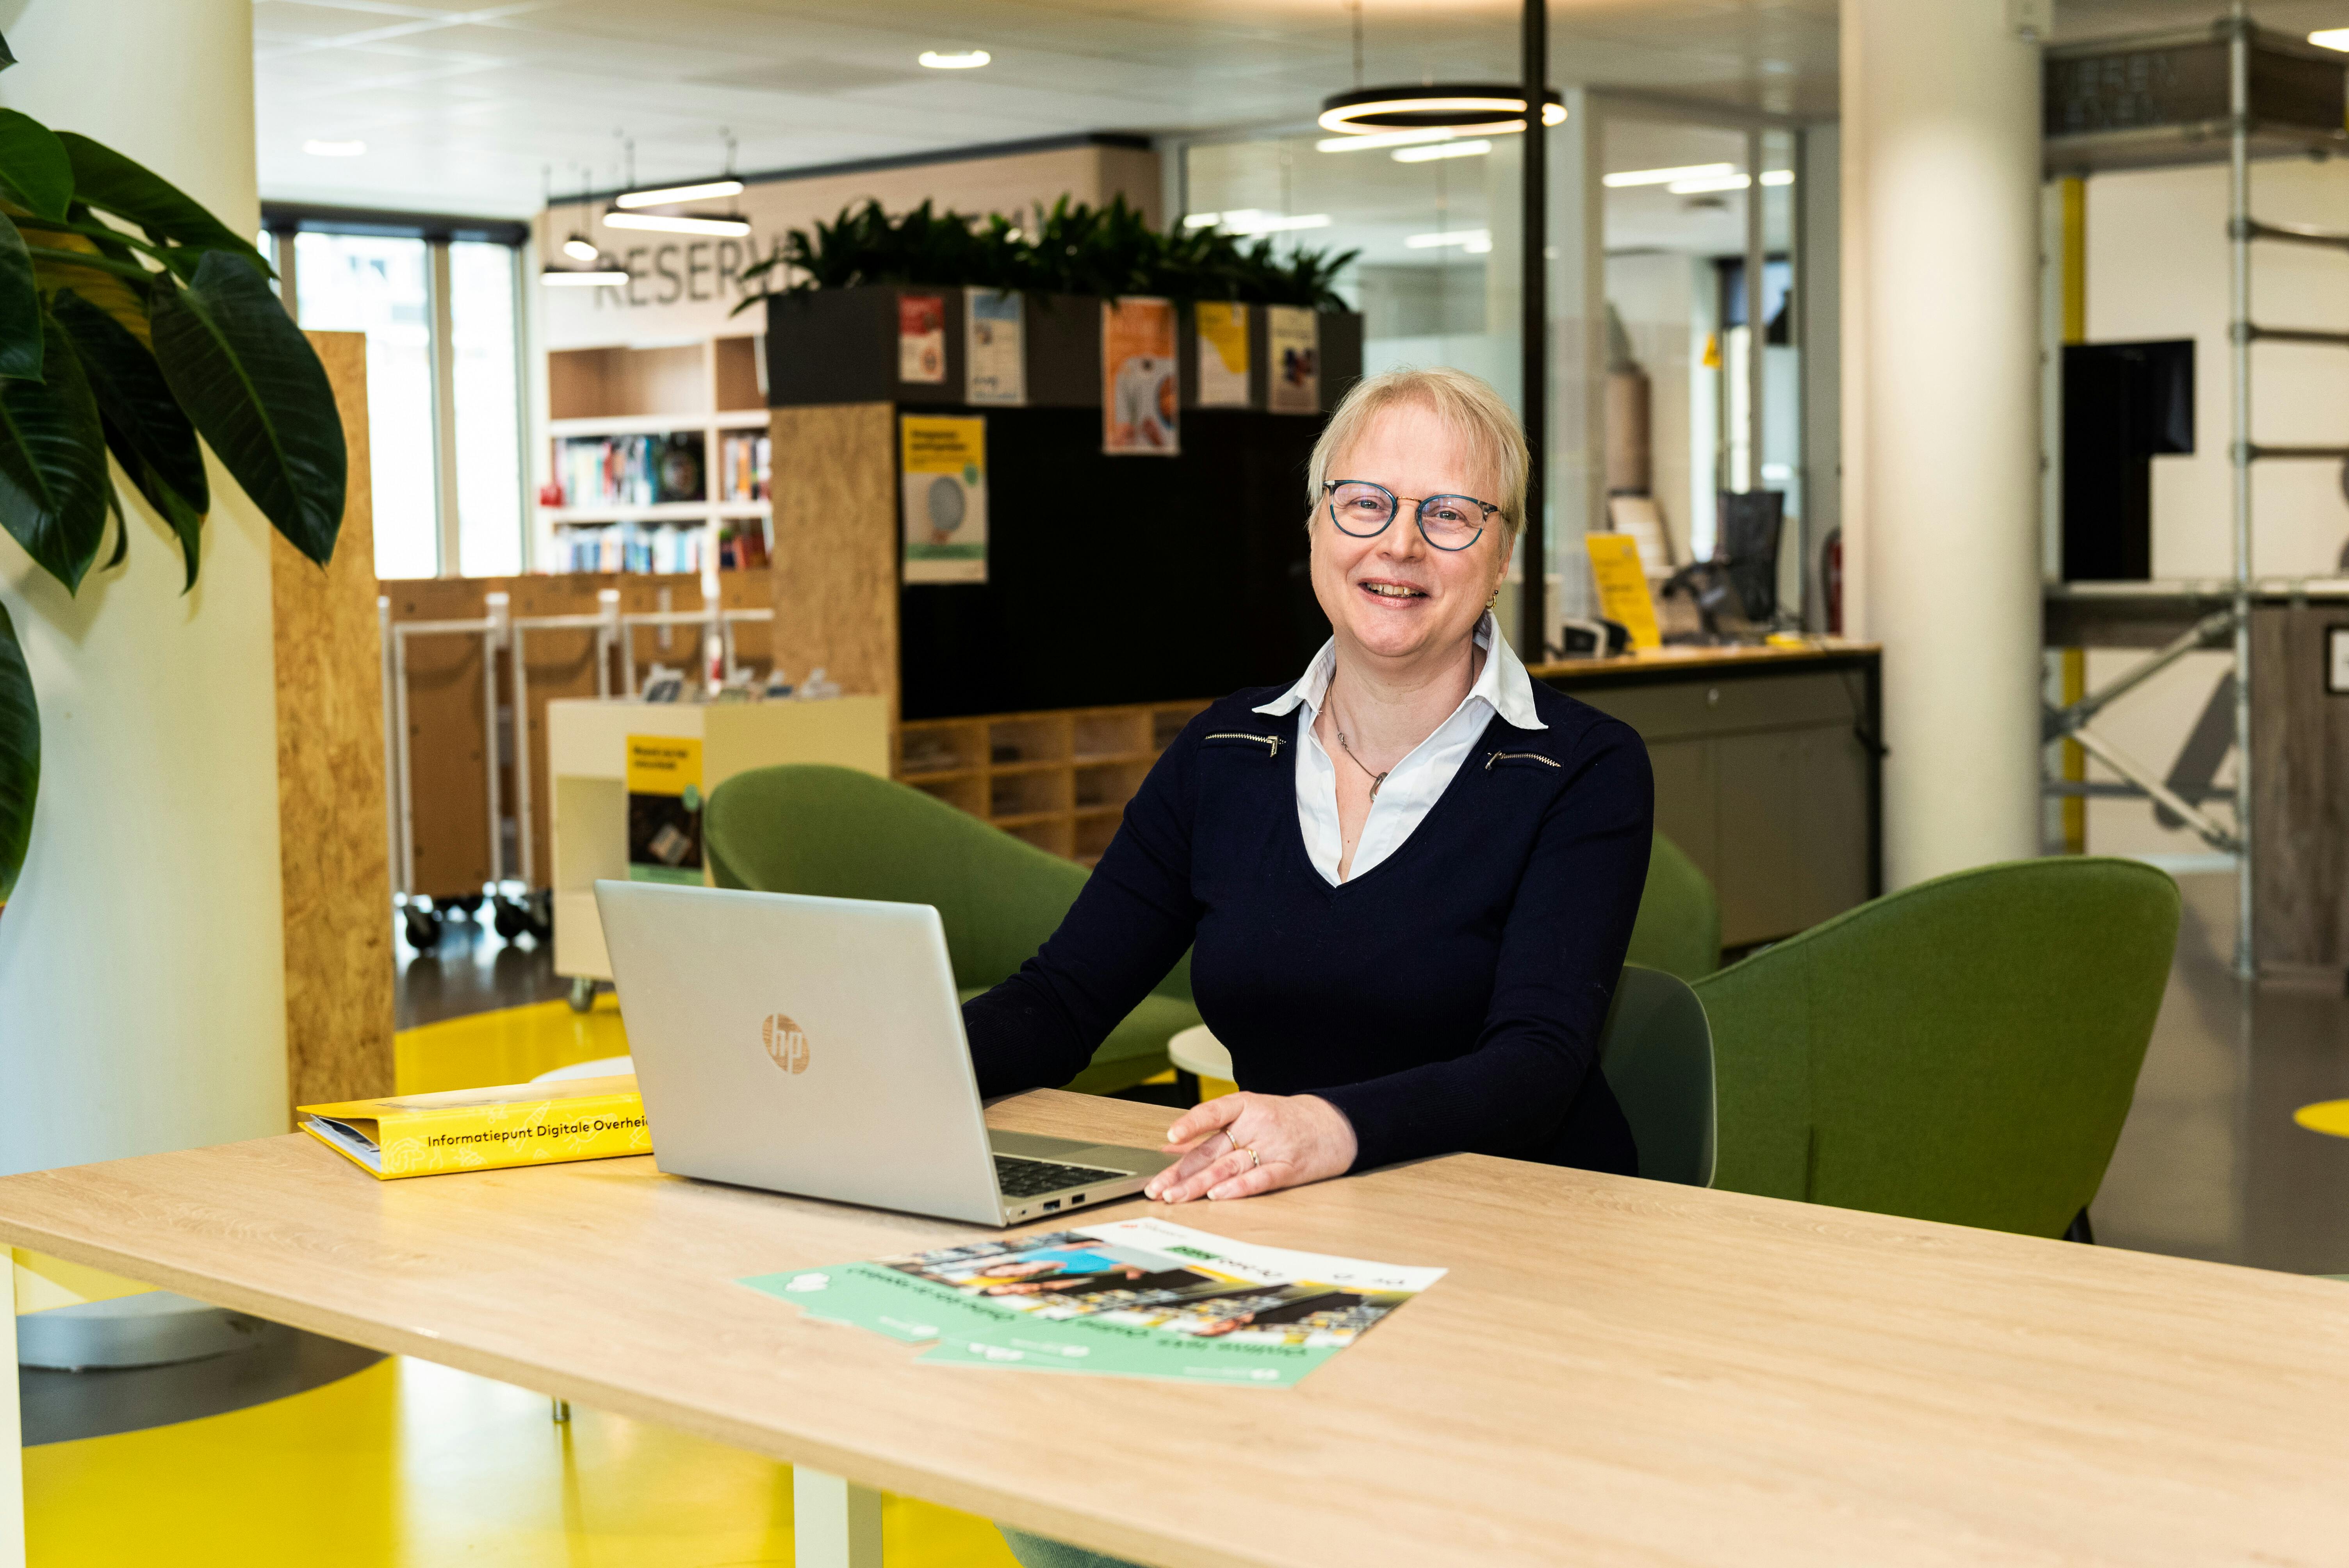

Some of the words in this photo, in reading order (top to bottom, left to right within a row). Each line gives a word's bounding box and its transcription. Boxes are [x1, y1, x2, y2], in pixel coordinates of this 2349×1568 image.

[769, 1014, 805, 1074] hp
[428, 1128, 533, 1147] Informatiepunt
[537, 1122, 590, 1138] Digitale
[593, 1115, 648, 1131] Overhei
